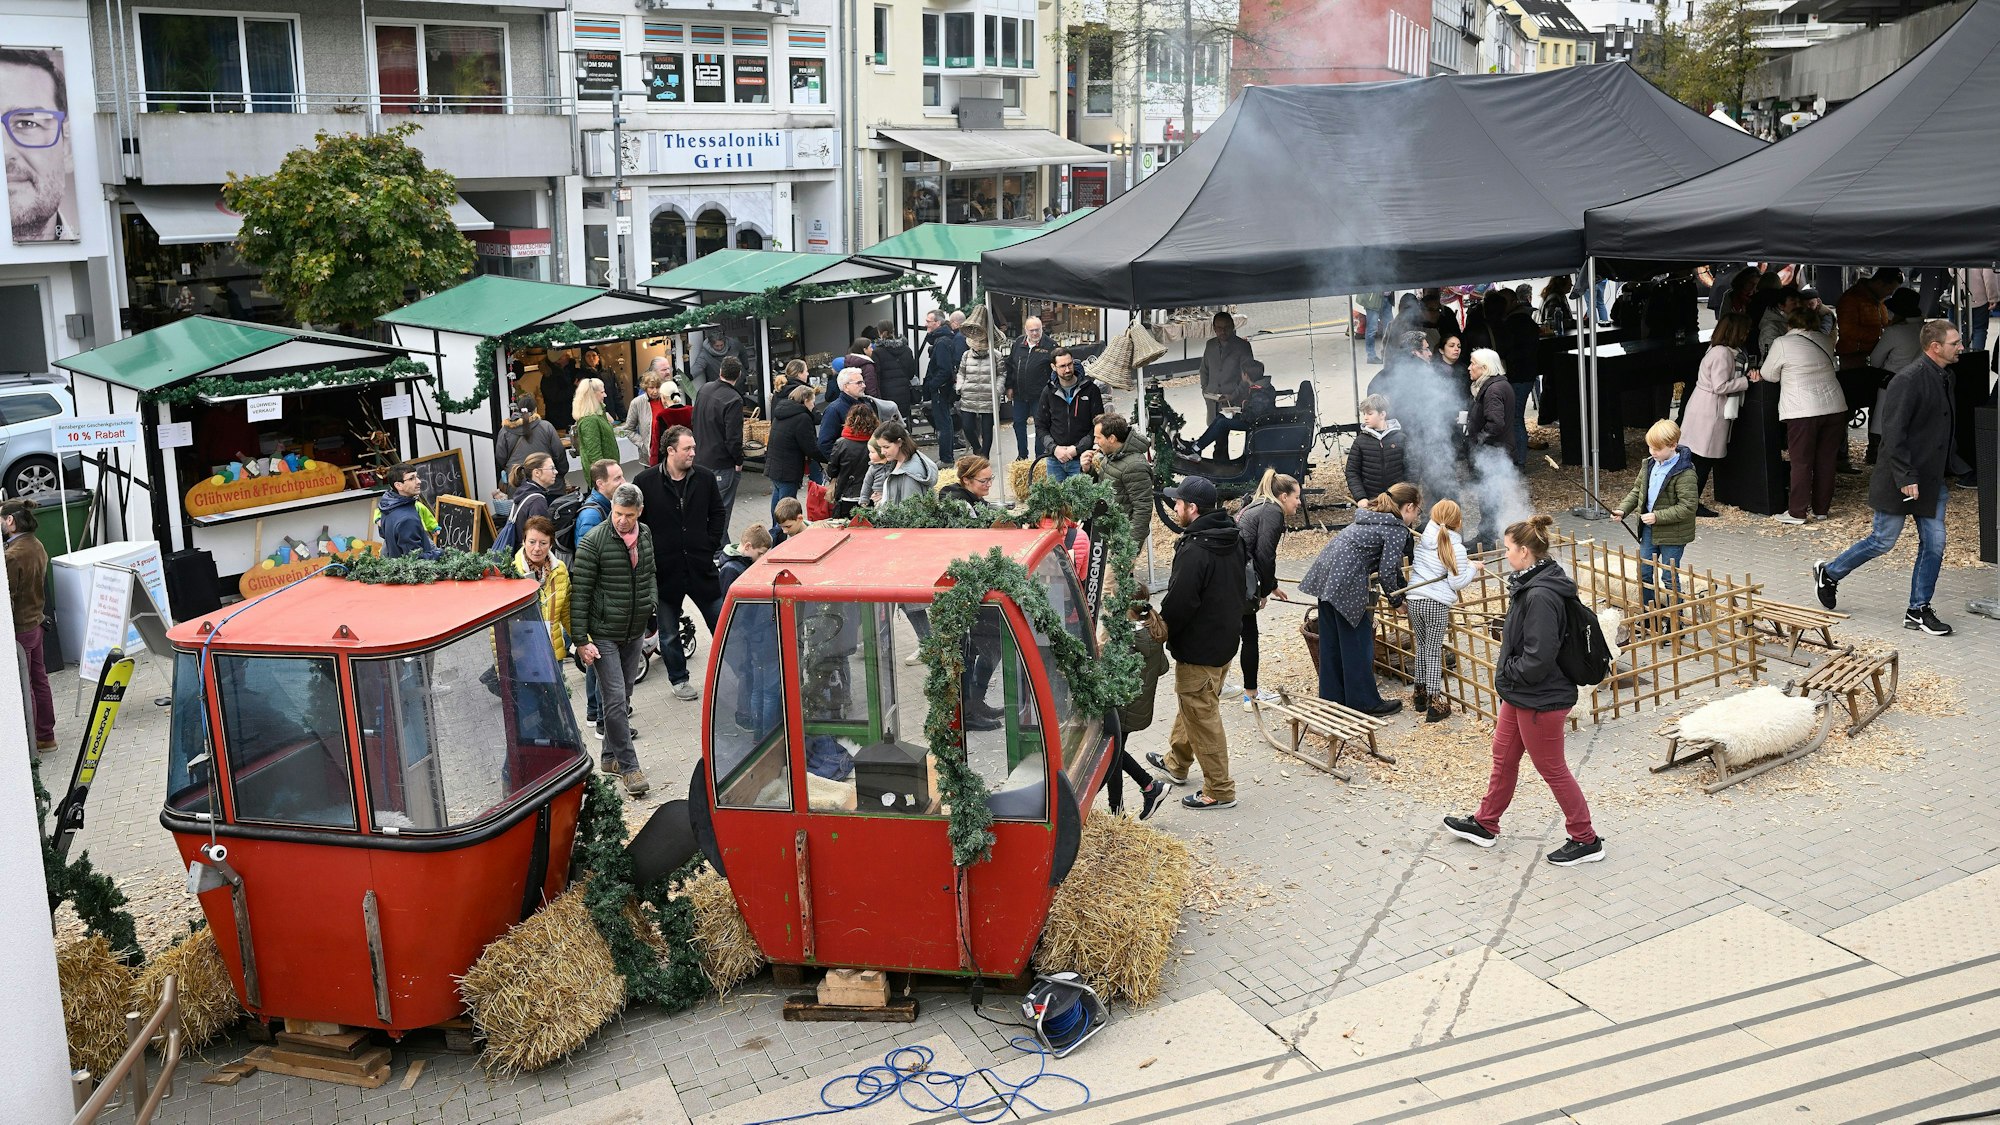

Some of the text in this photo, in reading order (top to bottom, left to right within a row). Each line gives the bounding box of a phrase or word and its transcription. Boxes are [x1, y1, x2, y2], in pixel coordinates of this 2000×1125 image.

[694, 64, 721, 80] 123
[663, 132, 780, 149] Thessaloniki
[694, 152, 753, 168] Grill
[780, 191, 788, 199] 50
[58, 422, 86, 430] Bensberger
[67, 429, 126, 441] 10 % Rabatt
[194, 473, 337, 507] Glühwein & Fruchtpunsch
[247, 569, 302, 592] Glühwein
[303, 566, 310, 577] &
[1087, 538, 1104, 618] OSSIGNOL
[91, 706, 112, 755] ROSSIGNOL
